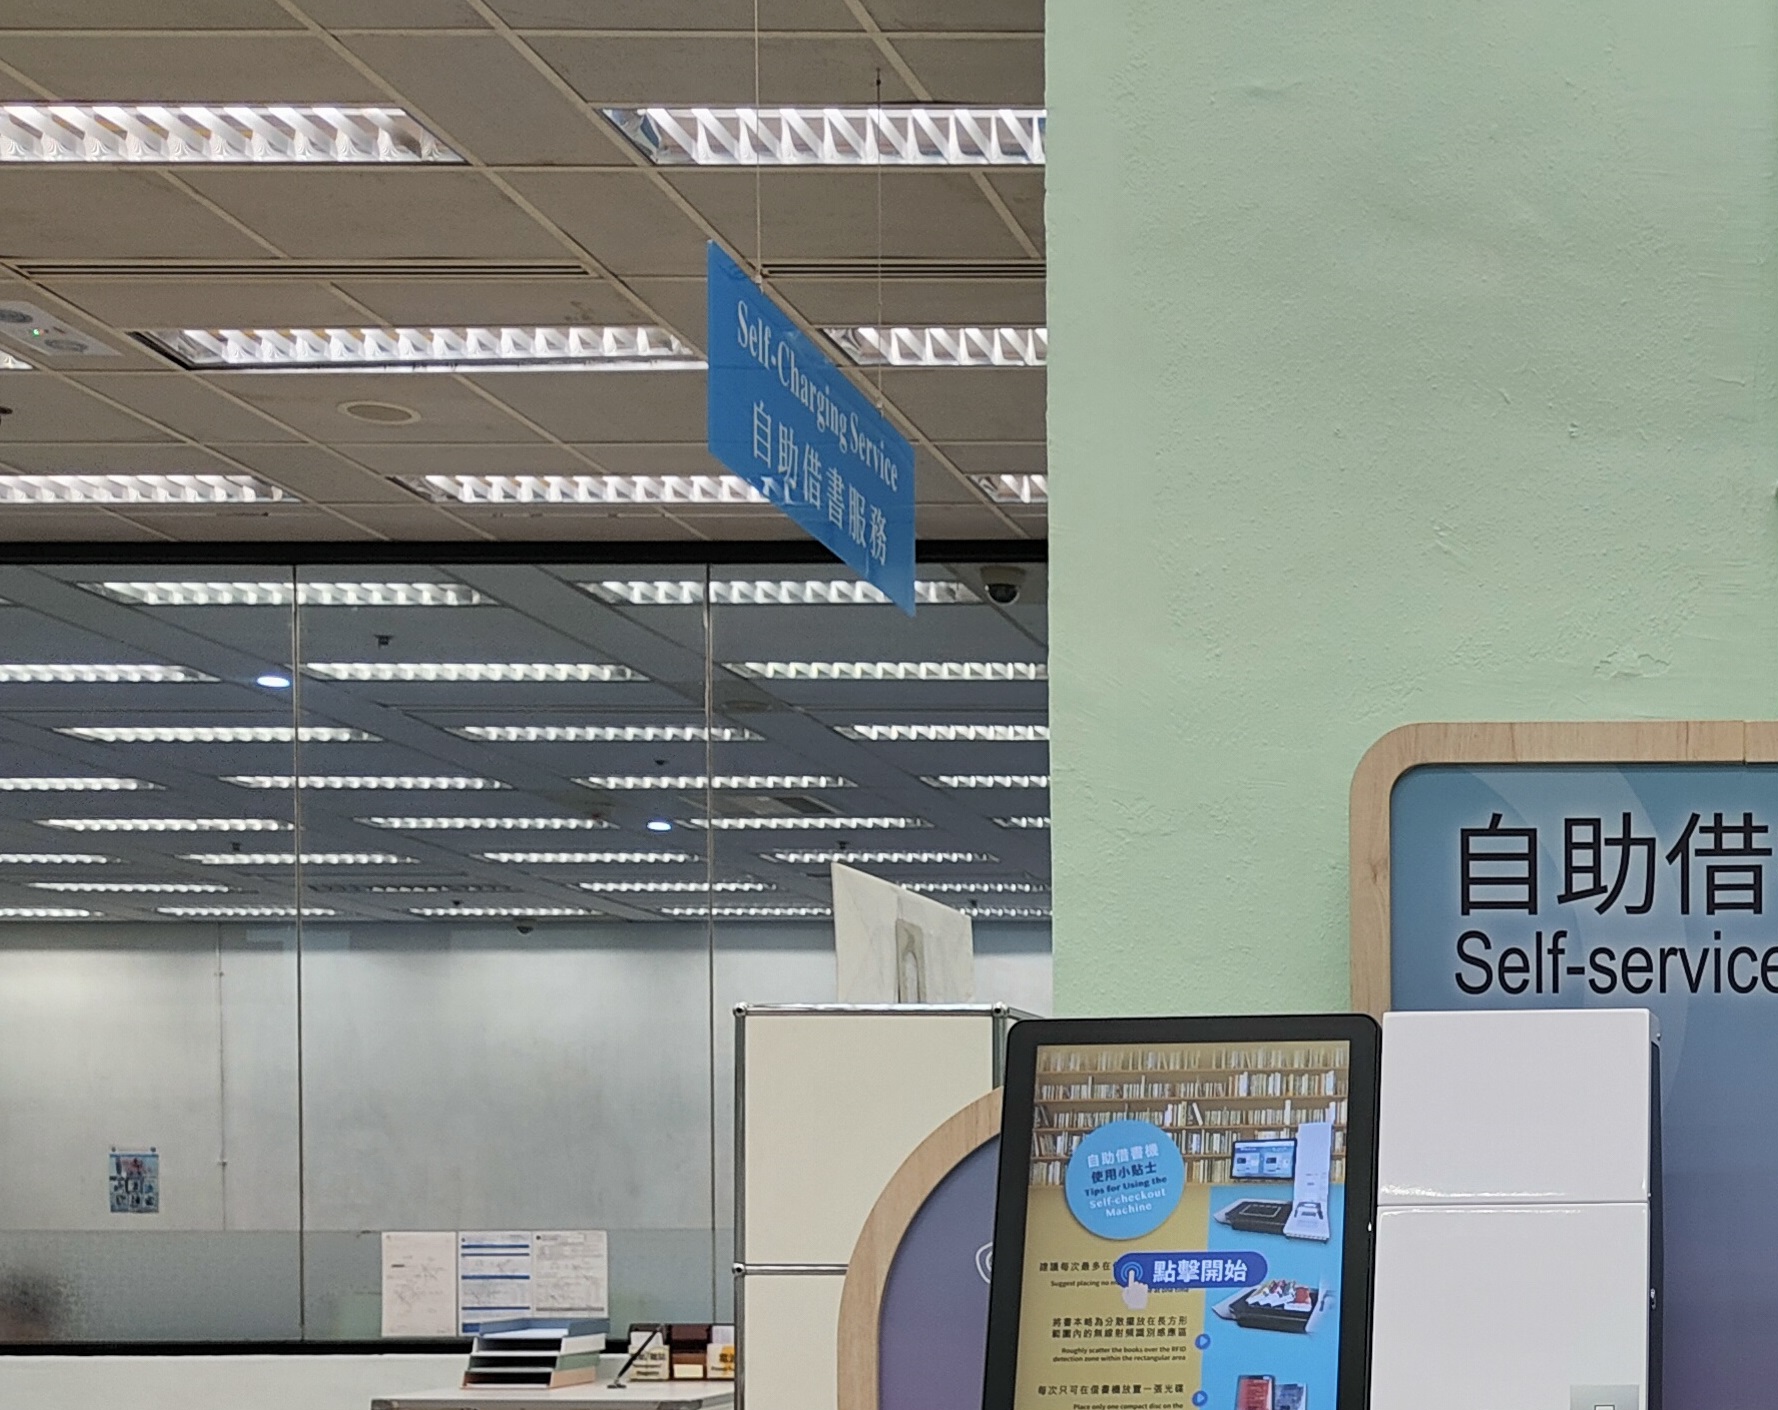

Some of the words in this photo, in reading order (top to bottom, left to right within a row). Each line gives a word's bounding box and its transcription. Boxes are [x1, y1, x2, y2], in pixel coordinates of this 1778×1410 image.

[737, 300, 847, 454] Self-Charging
[849, 411, 898, 492] Service
[753, 400, 887, 565] 自助借書服務
[1088, 1143, 1159, 1168] 自助借書機
[1092, 1162, 1156, 1184] 使用小貼士
[1084, 1188, 1104, 1196] Tips
[1123, 1180, 1150, 1190] Using
[1152, 1176, 1167, 1184] the
[1089, 1188, 1166, 1209] Self-checkout
[1105, 1203, 1152, 1217] Machine
[1039, 1262, 1113, 1272] 建議每次最多在
[1153, 1260, 1247, 1282] 點擊開始
